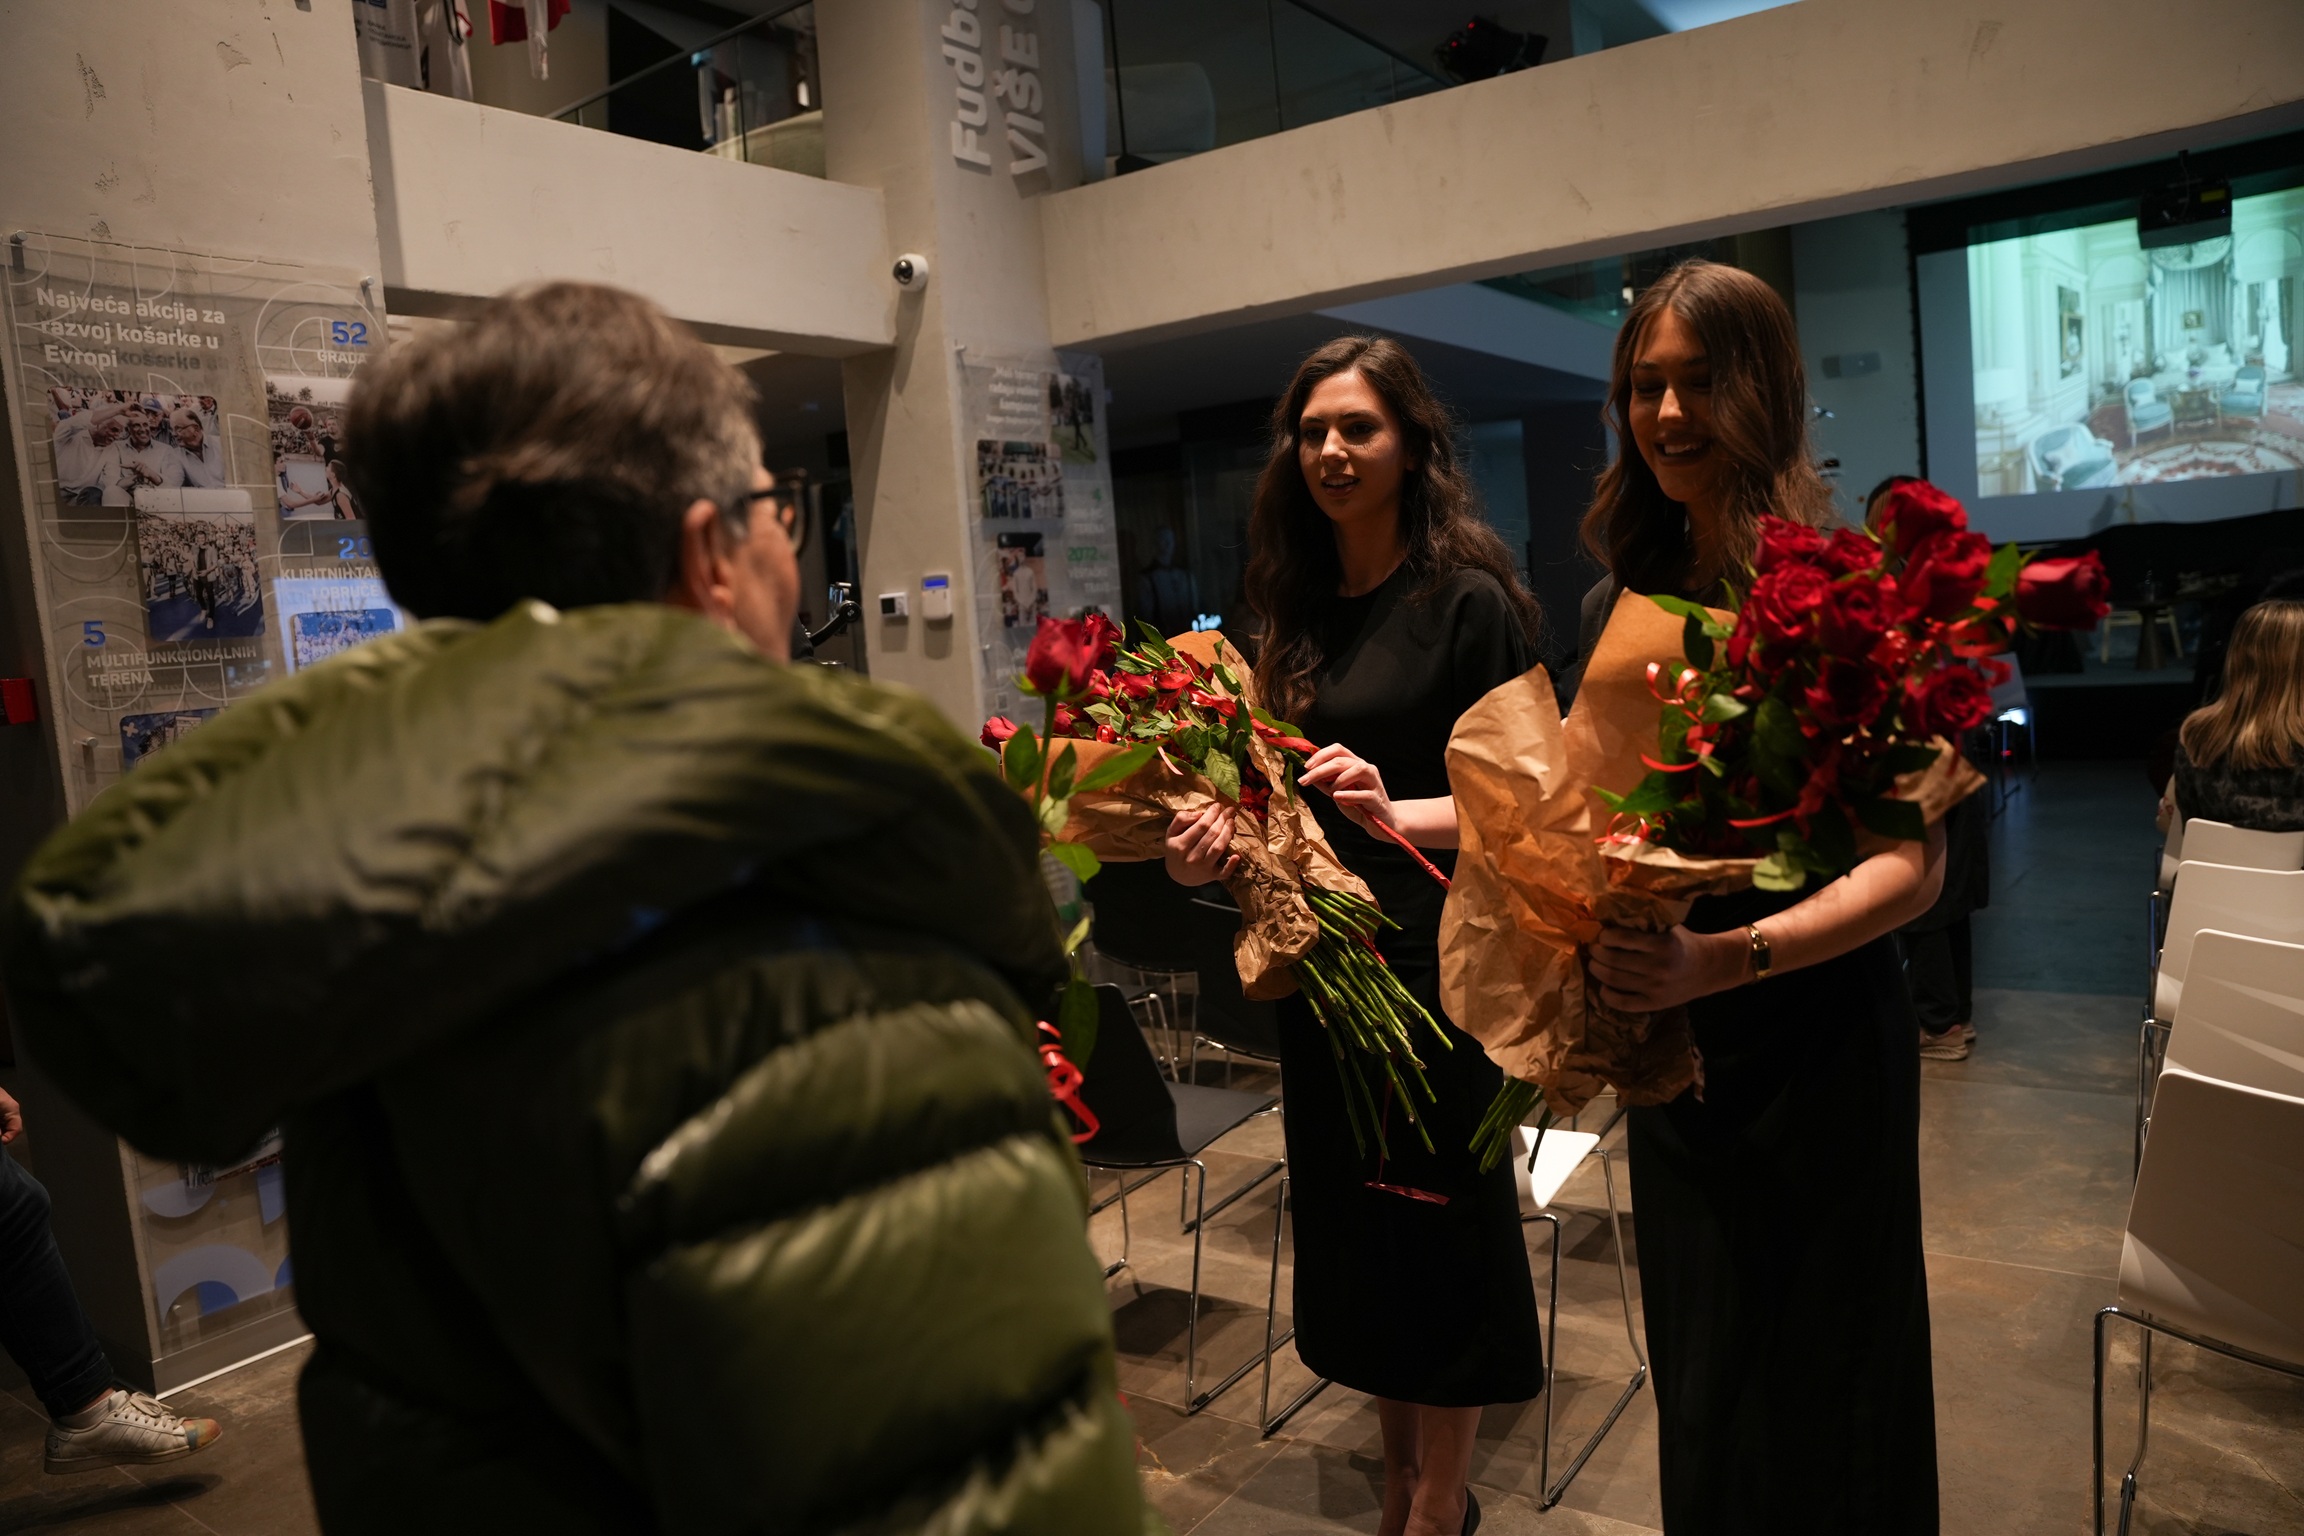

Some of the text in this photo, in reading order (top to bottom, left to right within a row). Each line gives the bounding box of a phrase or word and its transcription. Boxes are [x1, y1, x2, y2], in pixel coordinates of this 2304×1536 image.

[941, 0, 991, 166] Fudb
[992, 24, 1048, 174] VIŠE
[37, 287, 226, 326] Najveća akcija za
[40, 320, 220, 350] razvoj košarke u
[331, 320, 368, 345] 52
[44, 344, 118, 371] Evropi
[317, 350, 368, 365] GRADA
[84, 620, 106, 648] 5
[86, 645, 257, 669] MULTIFUNKCIONALNIH
[88, 672, 155, 688] TERENA
